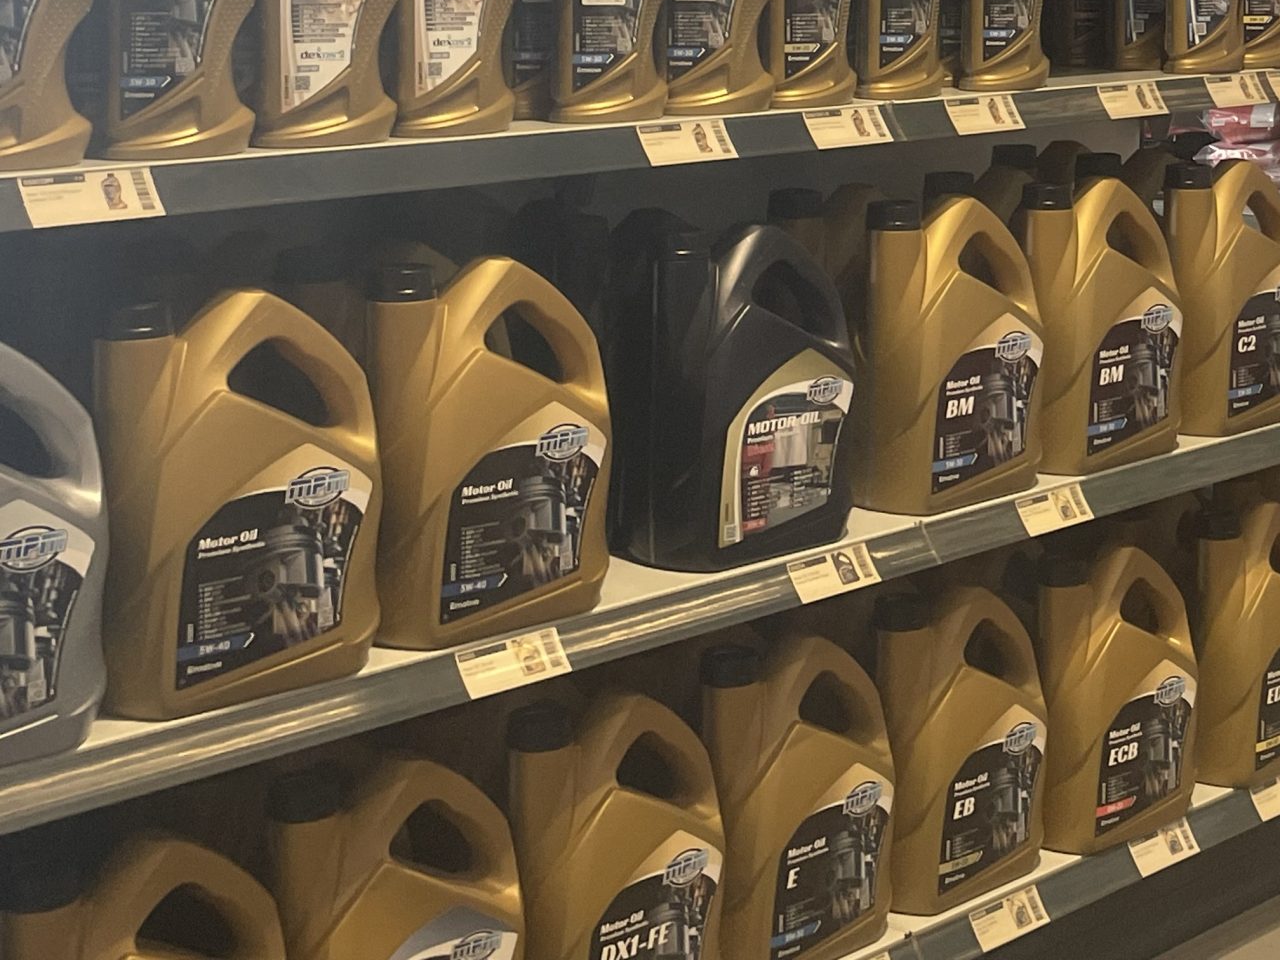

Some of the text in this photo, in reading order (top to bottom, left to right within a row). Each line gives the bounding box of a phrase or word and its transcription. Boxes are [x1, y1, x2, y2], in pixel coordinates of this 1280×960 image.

[1238, 319, 1254, 328] Motor
[1099, 345, 1129, 359] Motor Oil
[1238, 335, 1256, 353] C2
[946, 375, 981, 390] Motor Oil
[1099, 364, 1124, 386] BM
[946, 396, 975, 419] BM
[748, 411, 821, 435] MOTOR OIL
[462, 478, 513, 497] Motor Oil
[198, 528, 258, 551] Motor Oil
[1109, 723, 1141, 740] Motor Oil
[1108, 742, 1138, 767] ECB
[954, 772, 988, 792] Motor Oil
[953, 797, 975, 820] EB
[787, 837, 826, 859] Motor Oil
[786, 867, 800, 890] E
[600, 910, 644, 934] Motor Oil
[600, 922, 670, 960] DX1-FE
